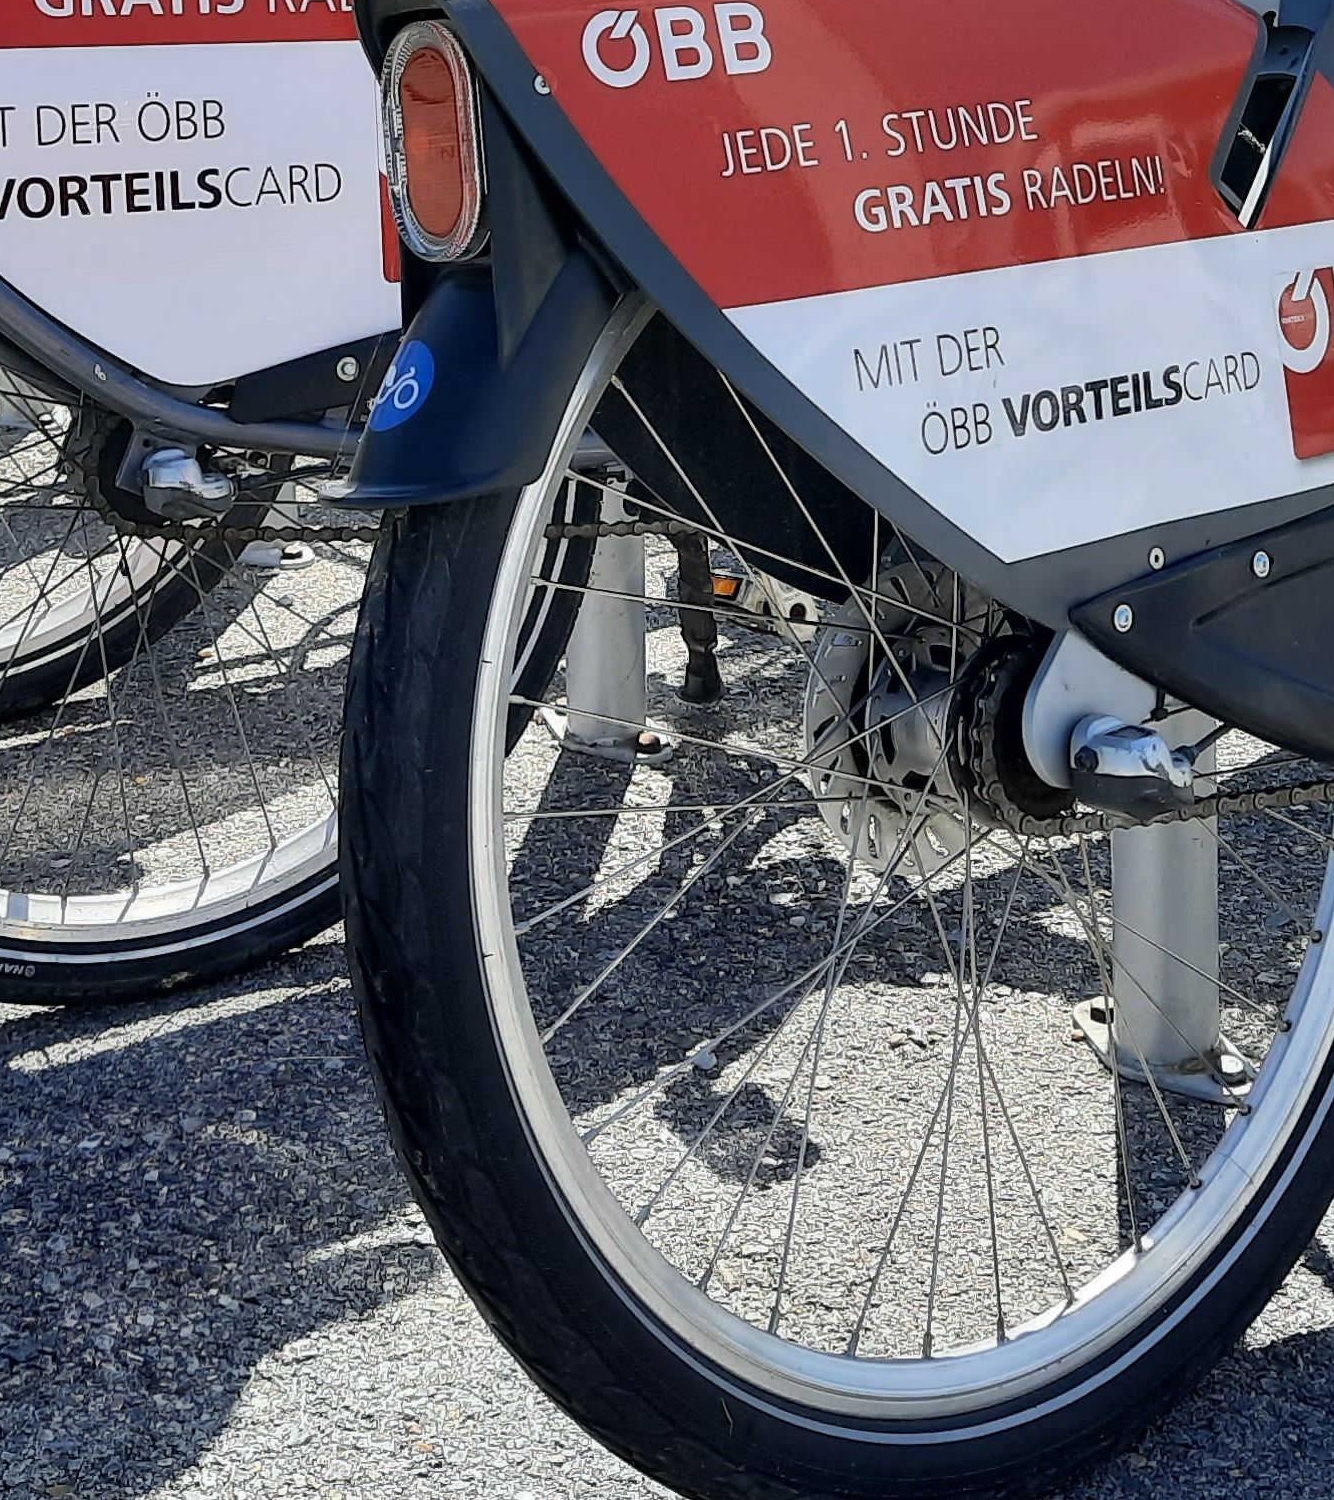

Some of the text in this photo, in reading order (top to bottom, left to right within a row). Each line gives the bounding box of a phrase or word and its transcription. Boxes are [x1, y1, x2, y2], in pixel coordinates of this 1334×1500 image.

[581, 2, 773, 88] ÖBB
[36, 103, 120, 147] DER
[137, 91, 226, 143] ÖBB
[720, 99, 1039, 177] JEDE 1. STUNDE
[854, 155, 1167, 233] GRATIS RADELN!
[853, 326, 1006, 392] MIT DER
[921, 350, 1261, 455] ÖBB VORTEILSCARD
